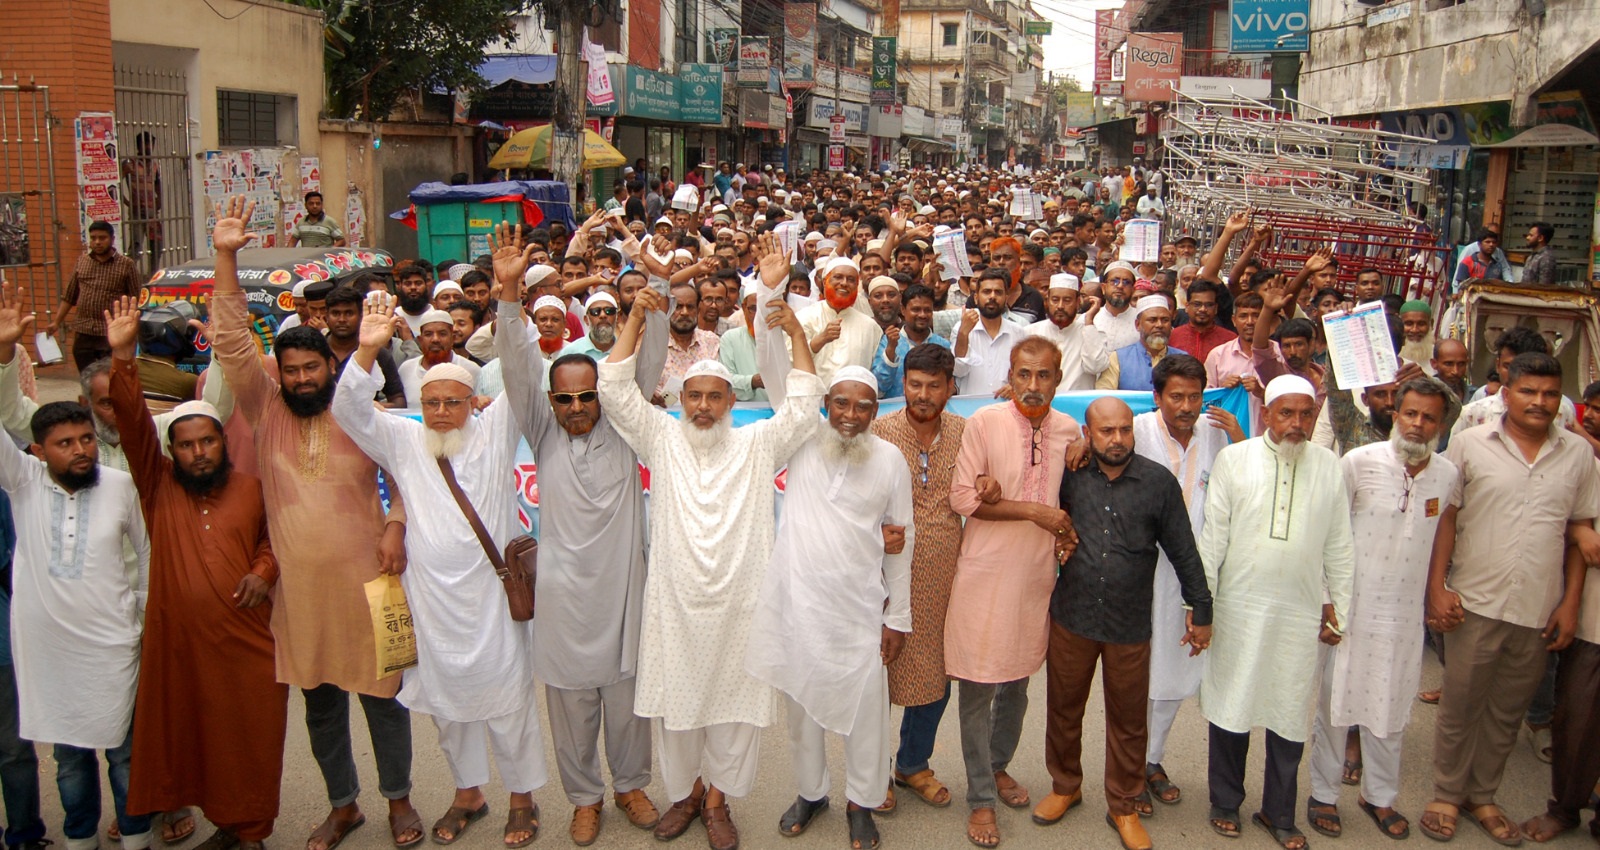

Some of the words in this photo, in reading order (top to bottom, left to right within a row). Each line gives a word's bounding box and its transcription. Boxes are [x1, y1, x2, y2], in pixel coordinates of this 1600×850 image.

[1131, 45, 1176, 68] Regal
[681, 72, 719, 84] এটিএম
[167, 269, 215, 281] মা-বাবা
